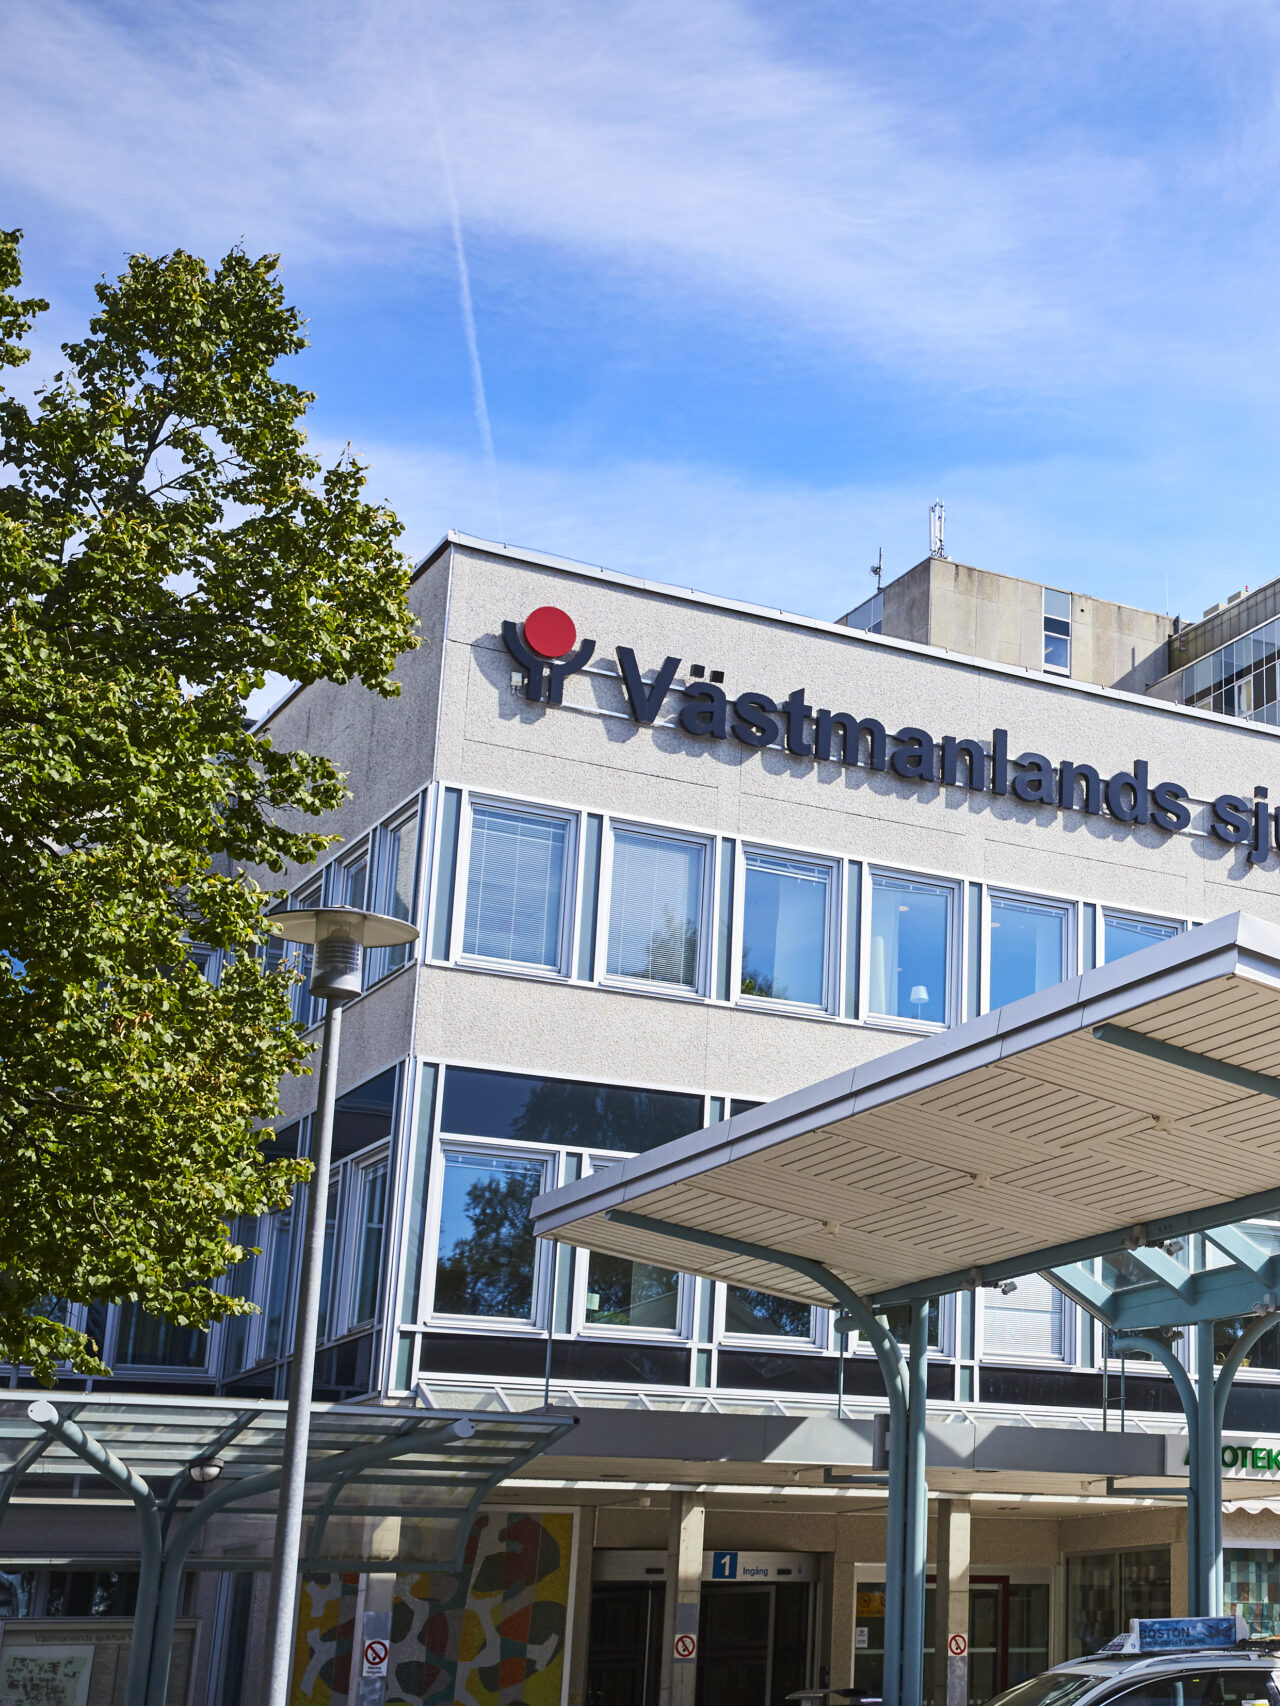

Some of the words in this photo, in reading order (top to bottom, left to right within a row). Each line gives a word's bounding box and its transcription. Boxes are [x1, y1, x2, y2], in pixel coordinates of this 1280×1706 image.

[615, 645, 1192, 832] Västmanlands
[720, 1555, 731, 1577] 1
[742, 1567, 769, 1577] Ingång
[1140, 1627, 1191, 1640] BOSTON
